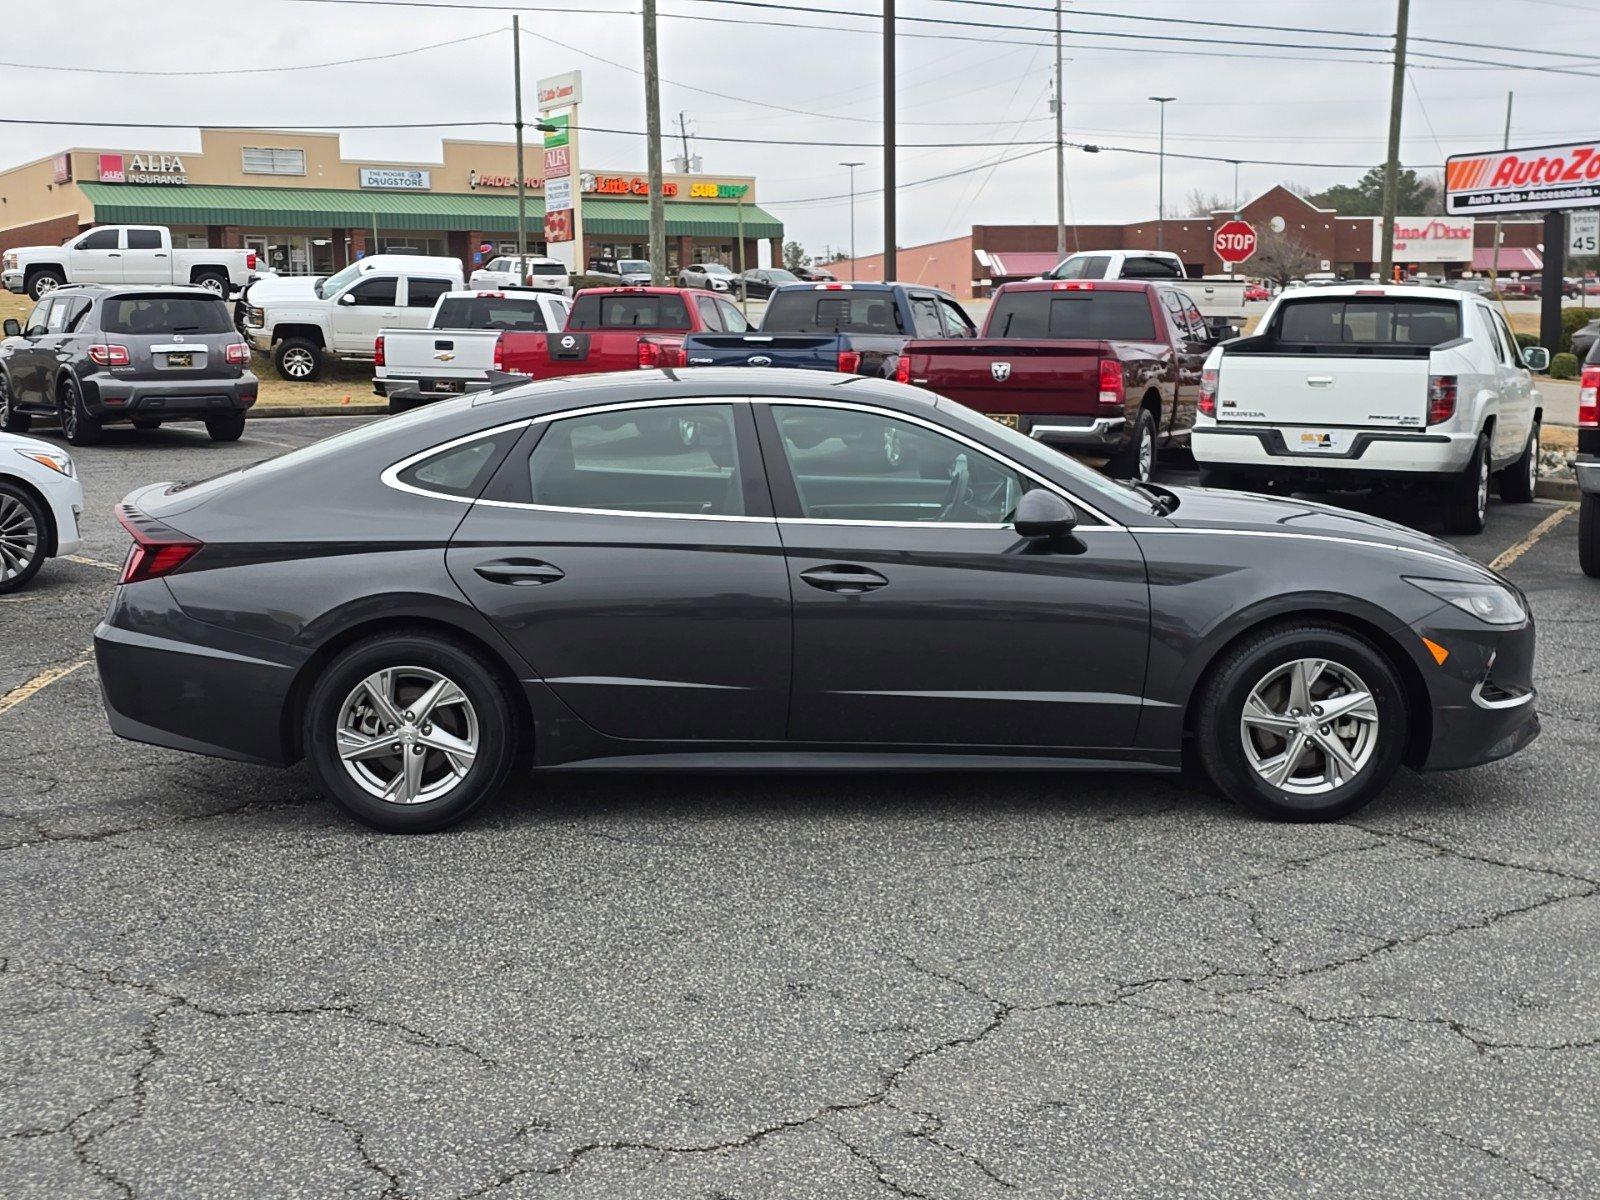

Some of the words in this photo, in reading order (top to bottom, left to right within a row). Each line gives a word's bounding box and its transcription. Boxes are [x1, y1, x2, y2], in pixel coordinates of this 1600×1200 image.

[129, 154, 186, 172] ALFA
[1490, 148, 1600, 187] AutoZo
[128, 174, 187, 184] INSURANCE
[368, 177, 423, 187] DRUGSTORE
[480, 175, 510, 187] FADE
[596, 176, 629, 193] Little
[690, 184, 749, 198] SUBWAY
[1468, 196, 1492, 205] Auto
[1493, 192, 1521, 203] Parts
[1527, 187, 1593, 200] Accessories
[1216, 233, 1254, 250] STOP
[1573, 237, 1596, 250] 45
